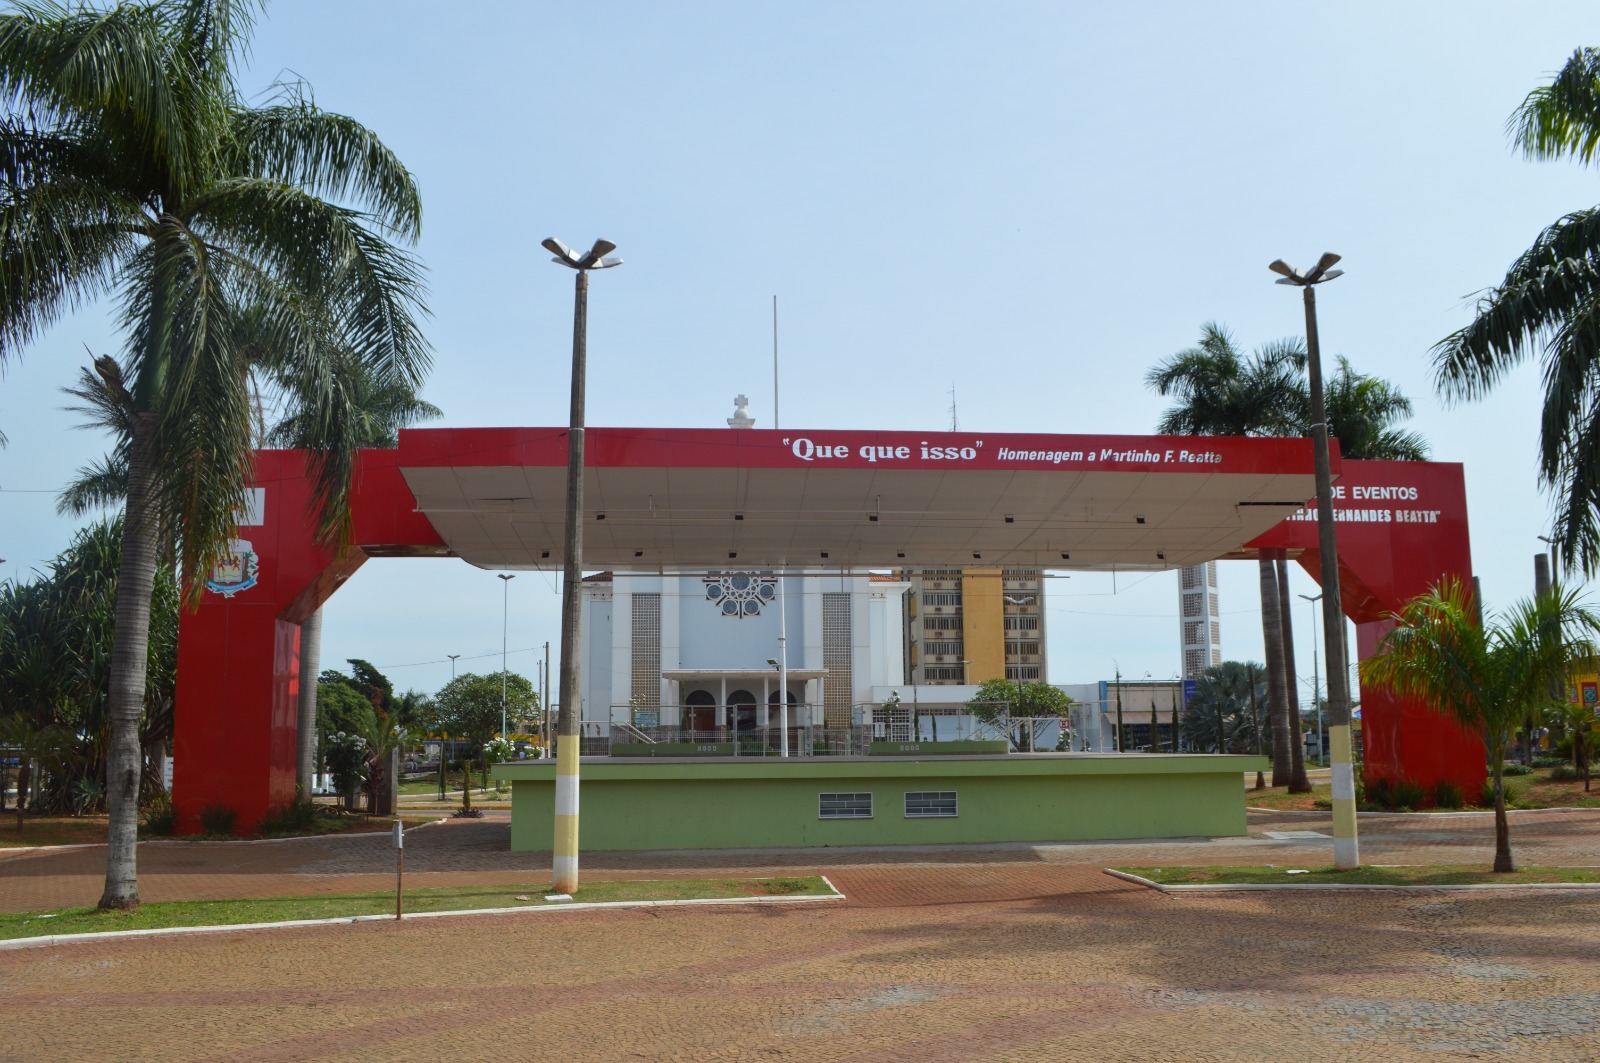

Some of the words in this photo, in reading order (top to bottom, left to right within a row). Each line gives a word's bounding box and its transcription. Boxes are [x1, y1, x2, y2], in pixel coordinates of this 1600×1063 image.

[859, 445, 911, 463] que
[997, 447, 1084, 464] Homenagem
[1087, 451, 1096, 461] a
[1099, 448, 1161, 463] Martinho
[1164, 450, 1175, 463] F.
[1179, 450, 1223, 464] Beatta
[1352, 486, 1418, 500] EVENTOS
